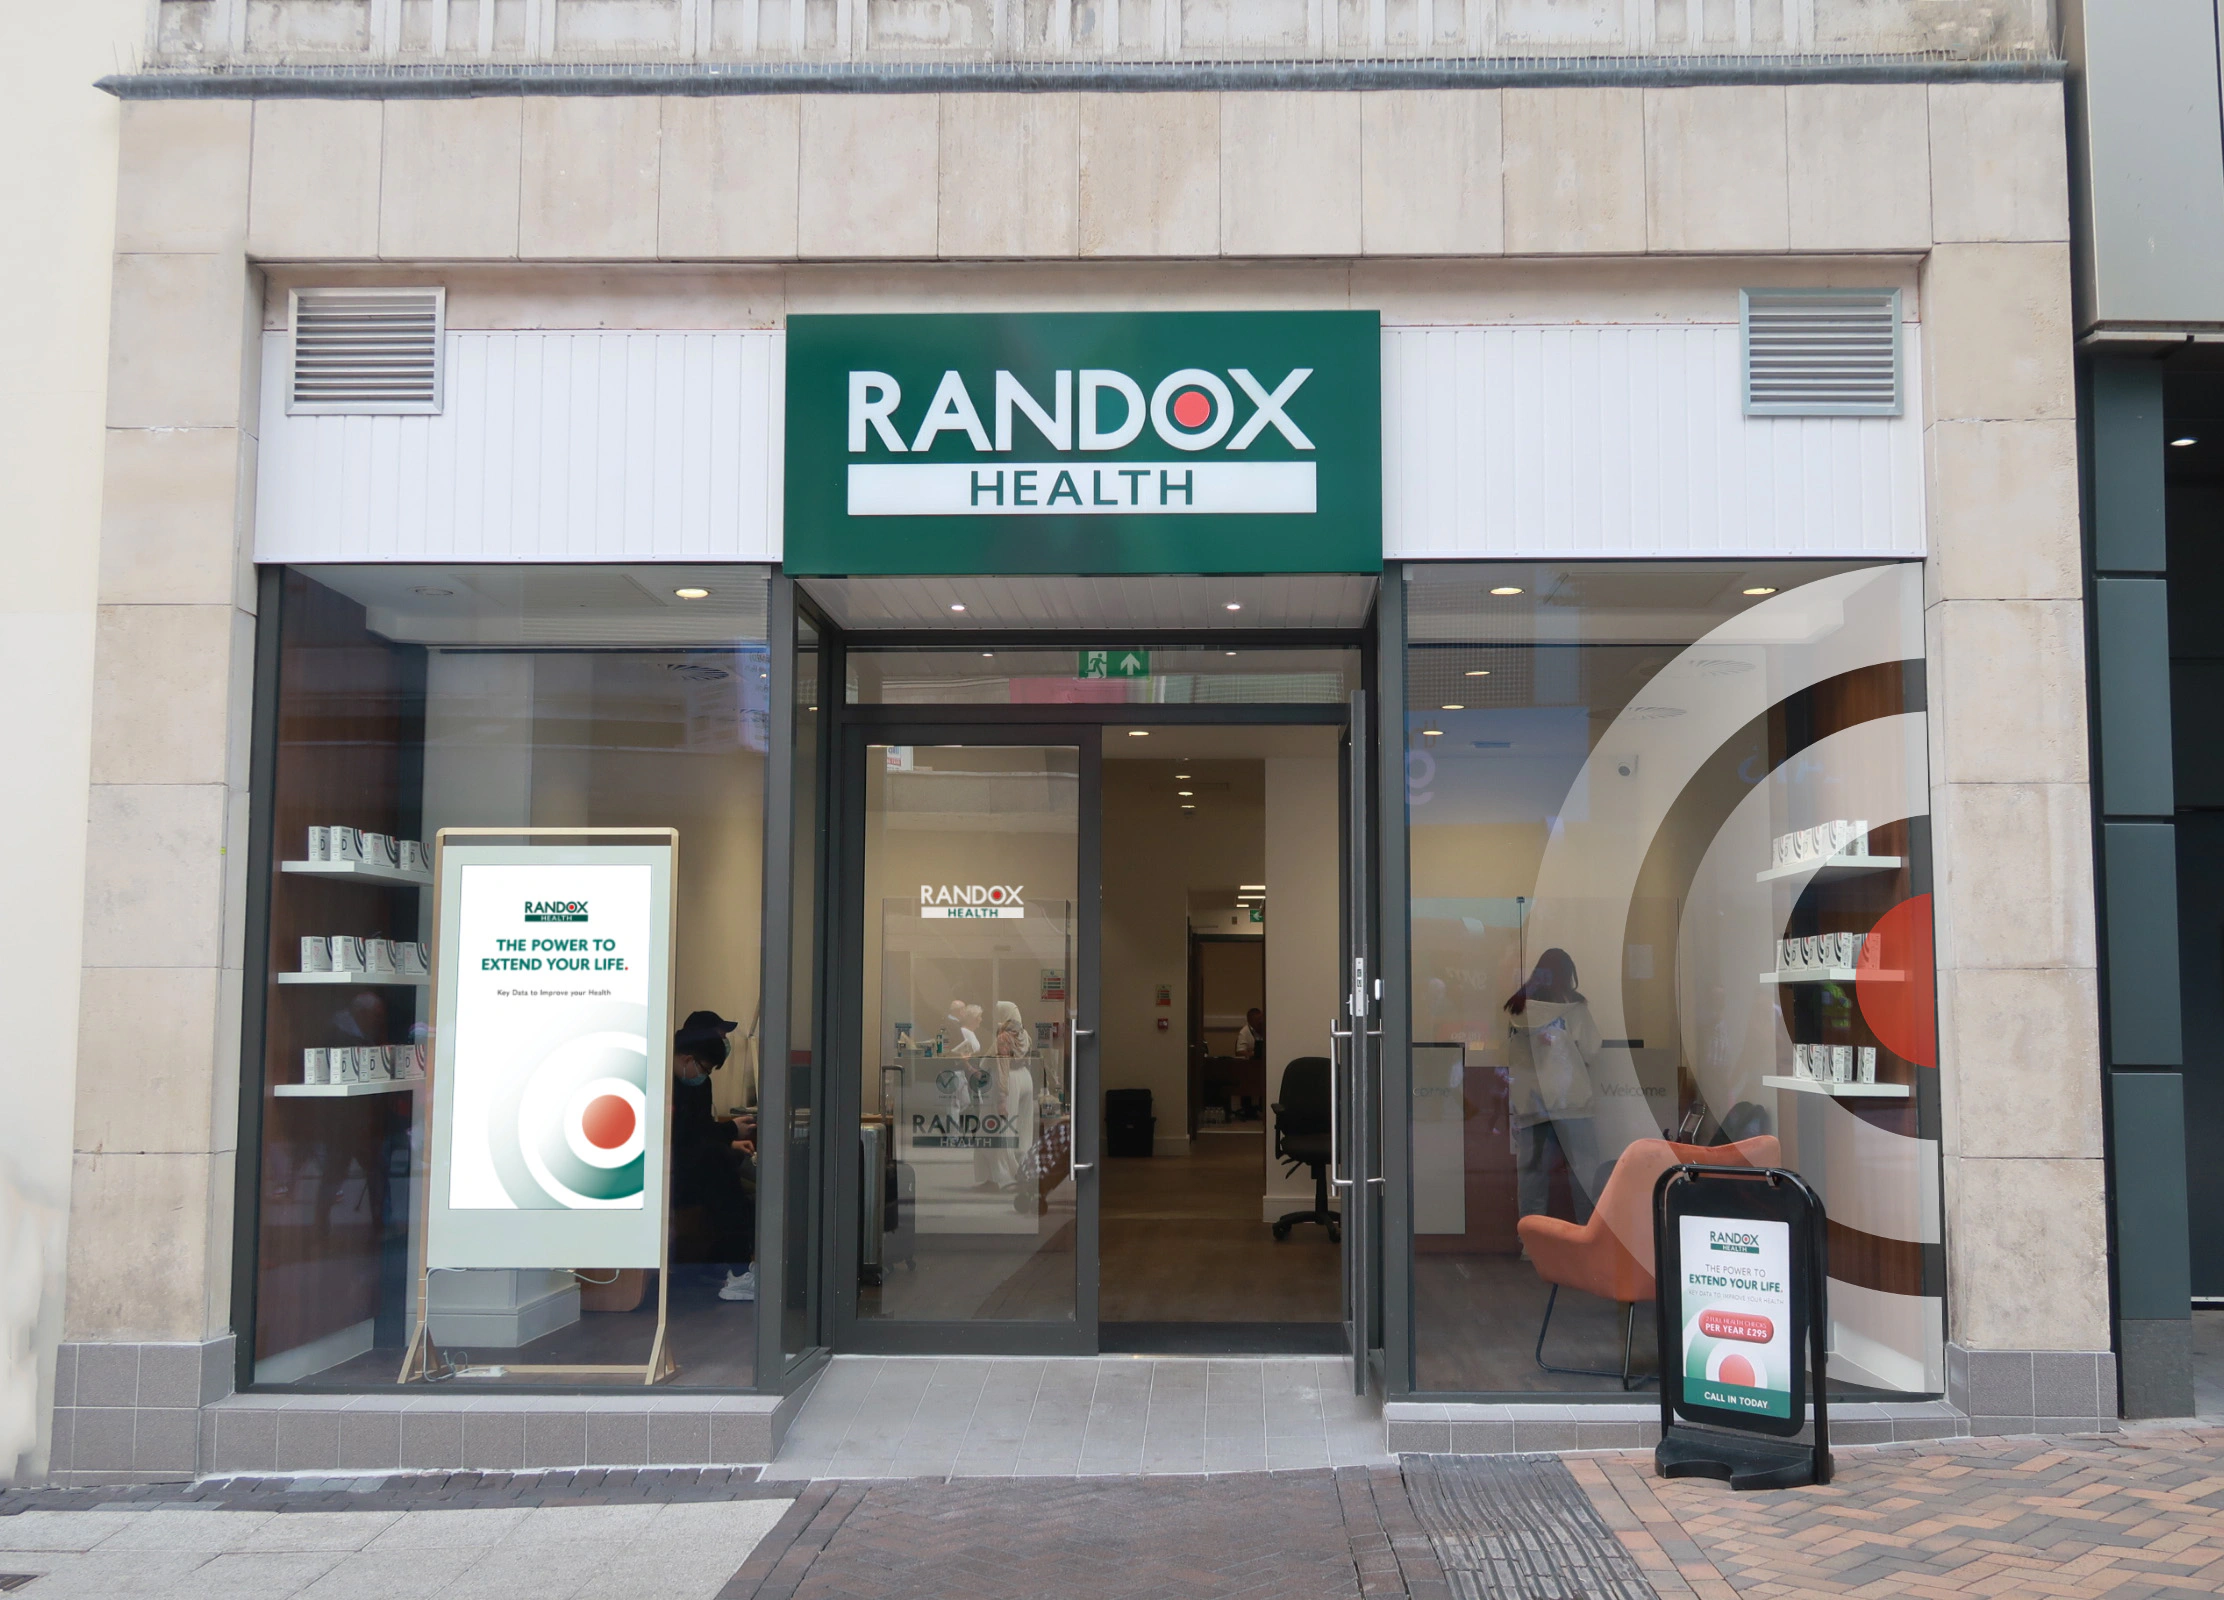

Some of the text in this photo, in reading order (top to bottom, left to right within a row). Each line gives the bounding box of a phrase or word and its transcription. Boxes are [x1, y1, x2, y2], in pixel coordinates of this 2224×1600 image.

[848, 368, 1316, 453] RANDOX
[970, 469, 1194, 507] HEALTH
[920, 885, 1024, 905] RANDOX
[525, 901, 588, 913] RANDOX
[948, 908, 999, 918] HEALTH
[496, 939, 616, 952] THE POWER TO
[481, 958, 629, 971] EXTEND YOUR LIFE.
[497, 989, 510, 997] Key
[540, 989, 569, 997] Improve
[912, 1114, 1019, 1134] RANDOX
[940, 1137, 992, 1147] HEALTH
[1710, 1231, 1759, 1246] RANDOX
[1722, 1245, 1748, 1253] HEALTH
[1705, 1264, 1766, 1278] THE POWER TO
[1689, 1274, 1784, 1293] EXTEND YOUR LIFE.
[1705, 1323, 1767, 1338] PER YEAR £295
[1704, 1391, 1726, 1402] CALL
[1727, 1395, 1737, 1404] IN
